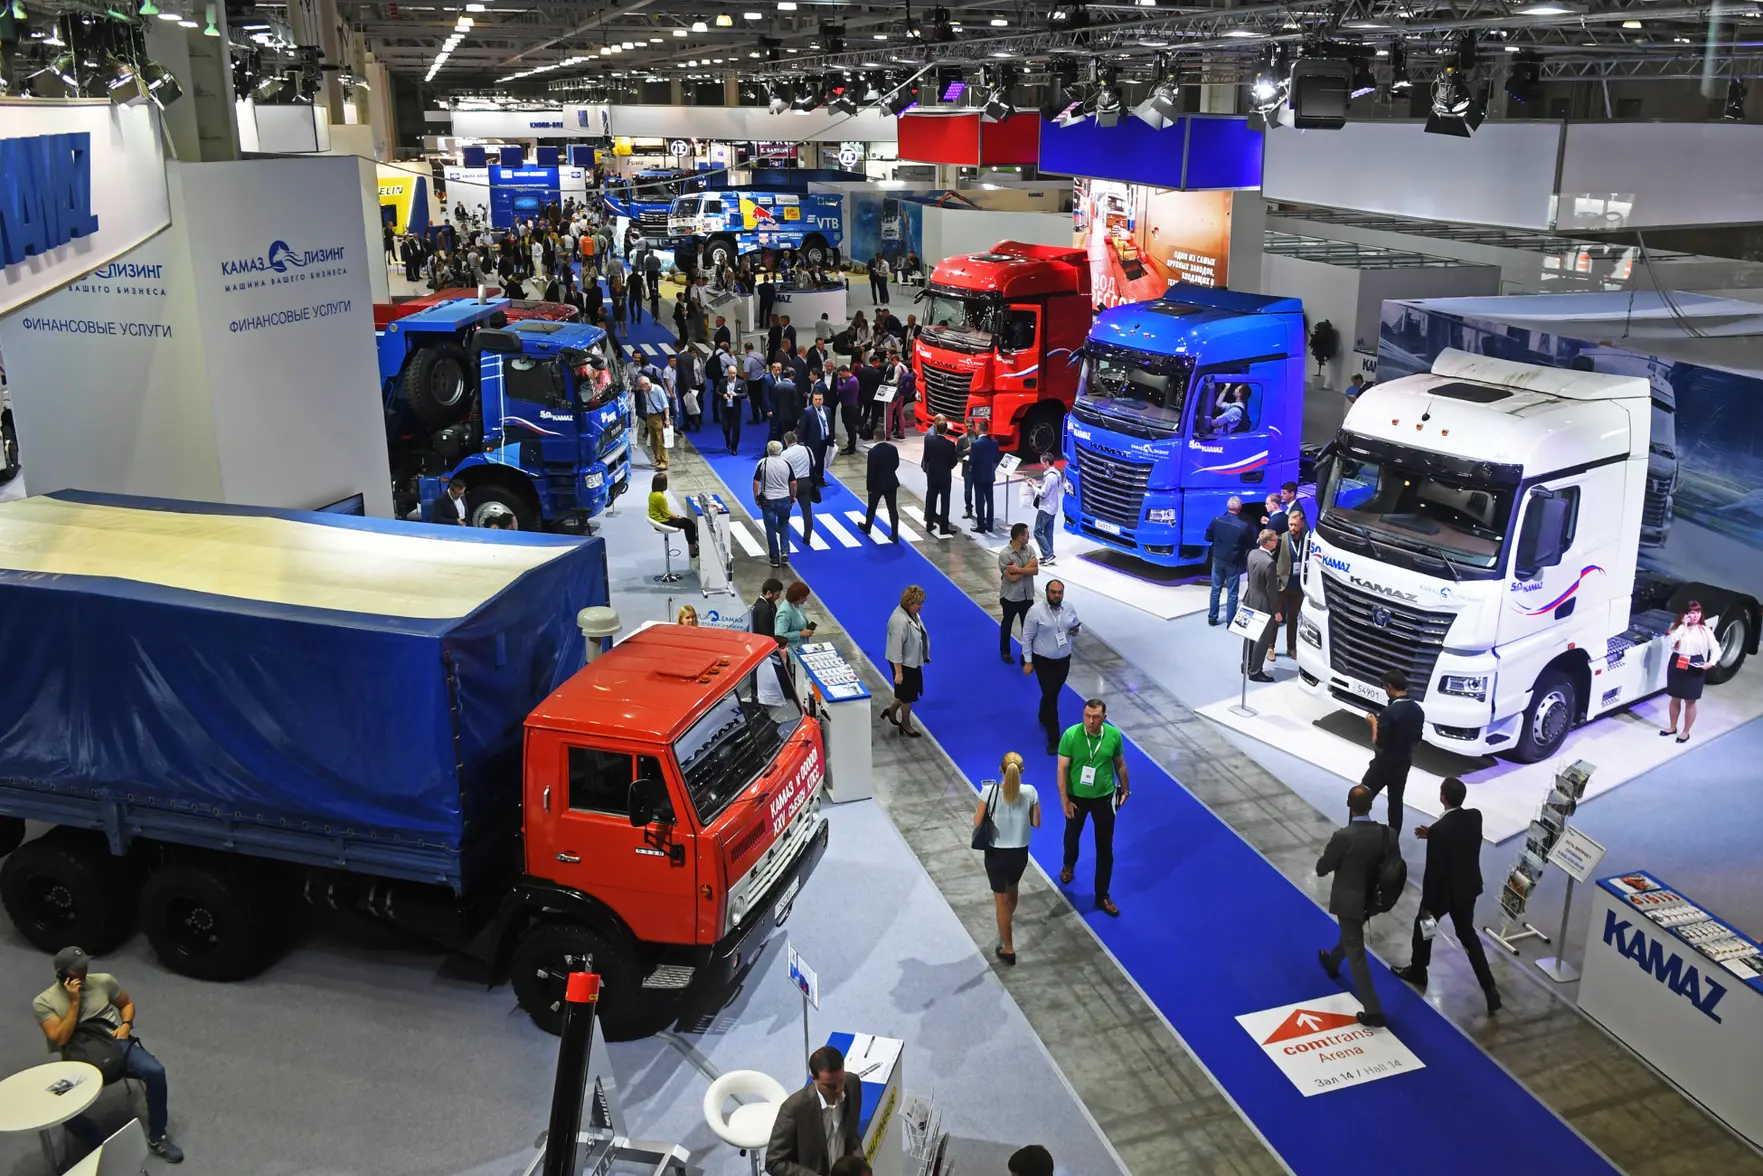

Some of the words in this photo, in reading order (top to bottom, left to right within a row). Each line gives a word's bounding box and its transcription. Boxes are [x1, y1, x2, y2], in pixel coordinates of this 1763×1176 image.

[378, 186, 403, 195] ELIN
[817, 217, 839, 229] VTB
[108, 263, 162, 279] ЛИЗИНГ
[221, 257, 265, 276] КАМАЗ
[303, 247, 345, 265] ЛИЗИНГ
[224, 280, 266, 292] МАШИНА
[271, 273, 306, 285] ВАШЕГО
[310, 268, 348, 279] БИЗНЕСА
[1093, 272, 1115, 297] ВОД
[117, 287, 166, 296] БИЗНЕСА
[774, 294, 792, 303] MAZ
[229, 307, 310, 333] ФИНАНСОВЫЕ
[312, 300, 351, 318] УСЛУГИ
[22, 317, 116, 336] ФИНАНСОВЫЕ
[121, 323, 172, 338] УСЛУГИ
[1090, 442, 1132, 458] KAMAZ
[1201, 446, 1224, 454] KAMAZ
[1322, 554, 1350, 573] KAMAZ
[1350, 575, 1418, 603] KAMAZ
[1523, 582, 1543, 593] KAMAZ
[1357, 685, 1380, 699] 54901
[770, 781, 794, 818] КАМАЗ
[773, 810, 785, 837] XXV
[1603, 909, 1728, 1025] KAMAZ
[1282, 1027, 1375, 1056] comtrans
[1319, 1045, 1365, 1063] Arena
[1314, 1075, 1339, 1087] Зал
[1340, 1071, 1355, 1081] 14
[1364, 1063, 1387, 1075] Hall
[1387, 1059, 1403, 1069] 14
